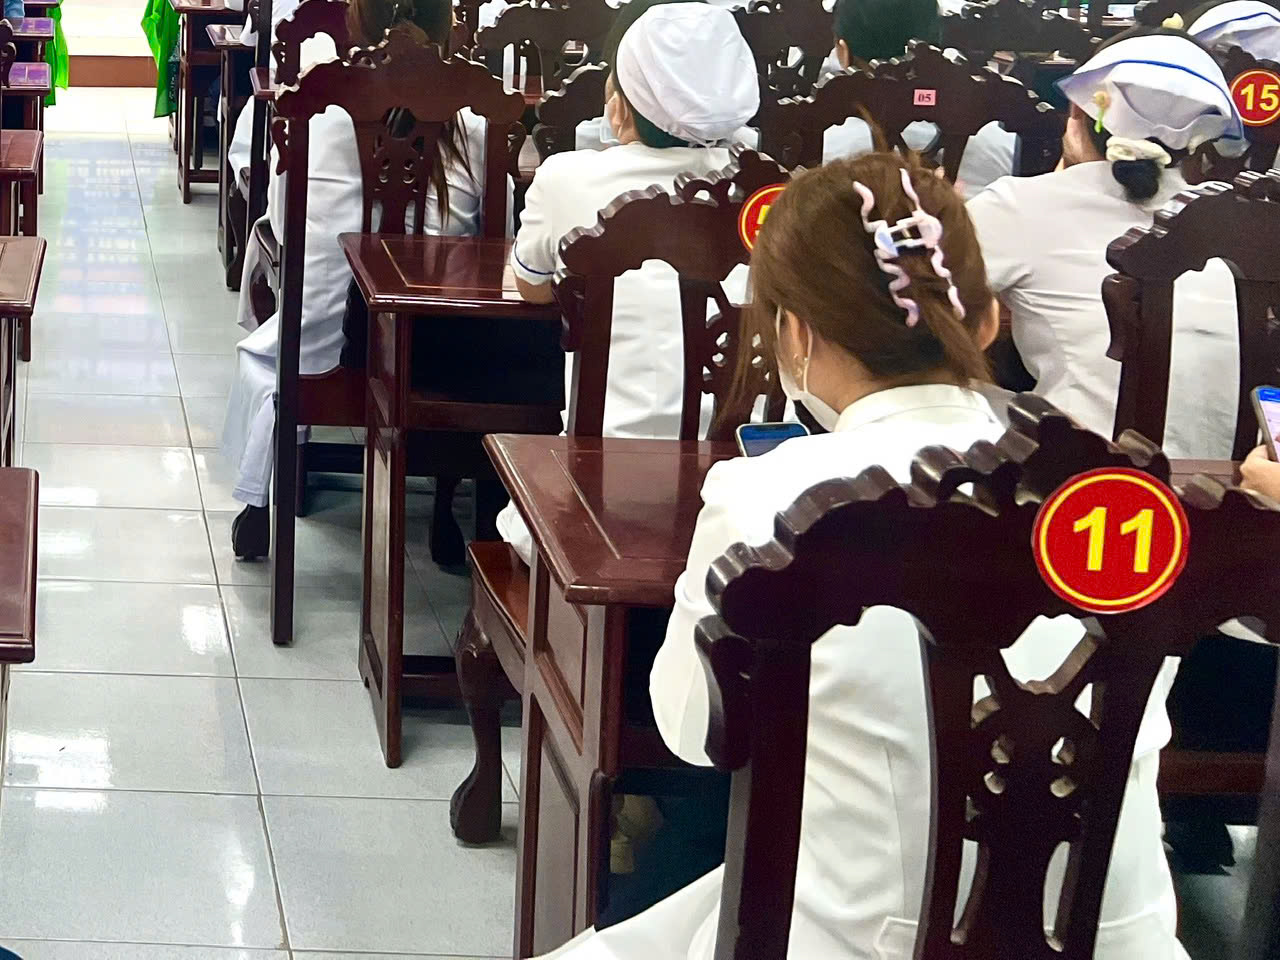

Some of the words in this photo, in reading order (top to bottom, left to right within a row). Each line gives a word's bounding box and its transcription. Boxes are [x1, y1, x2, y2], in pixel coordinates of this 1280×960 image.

[918, 93, 931, 102] 05
[1240, 83, 1279, 111] 15
[1073, 506, 1154, 573] 11
